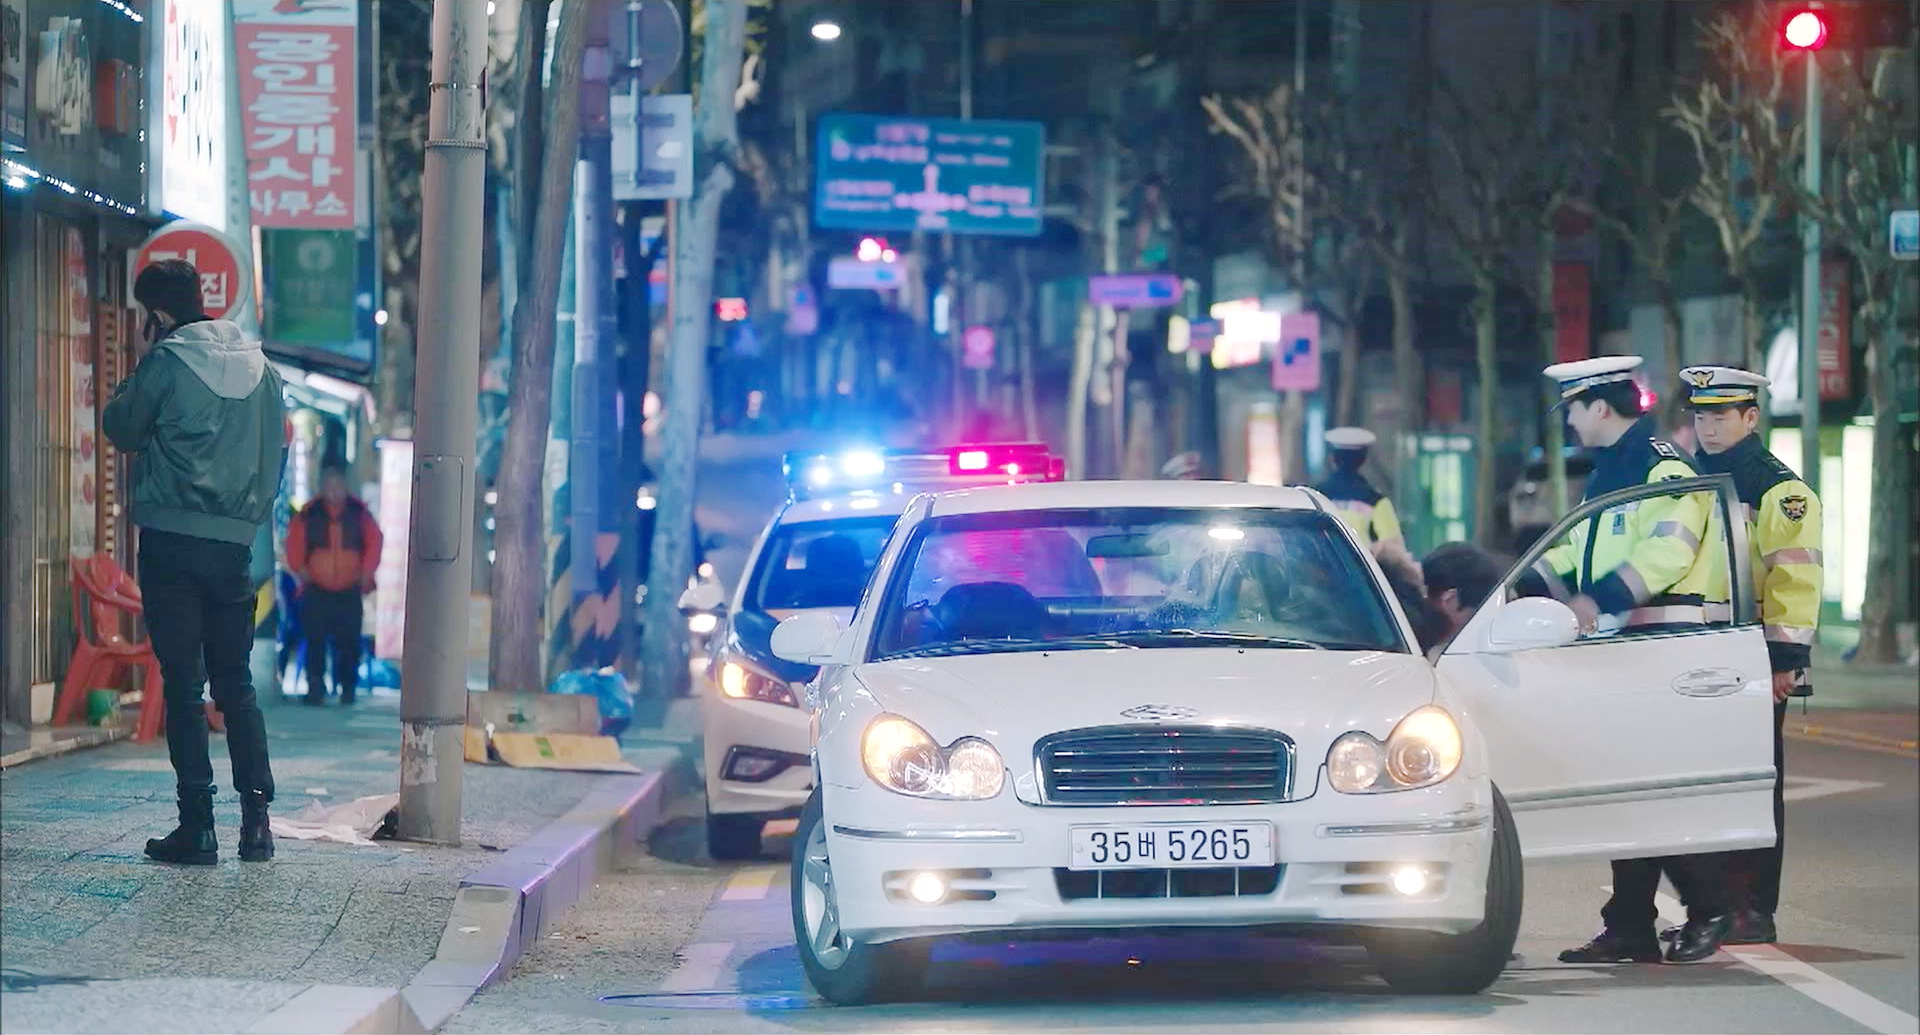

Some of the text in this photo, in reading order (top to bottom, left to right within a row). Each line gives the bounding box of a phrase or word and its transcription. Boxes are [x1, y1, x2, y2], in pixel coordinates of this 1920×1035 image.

[247, 31, 343, 187] 공인중개사
[250, 190, 347, 217] 사무소
[1090, 829, 1250, 863] 35버 5265
